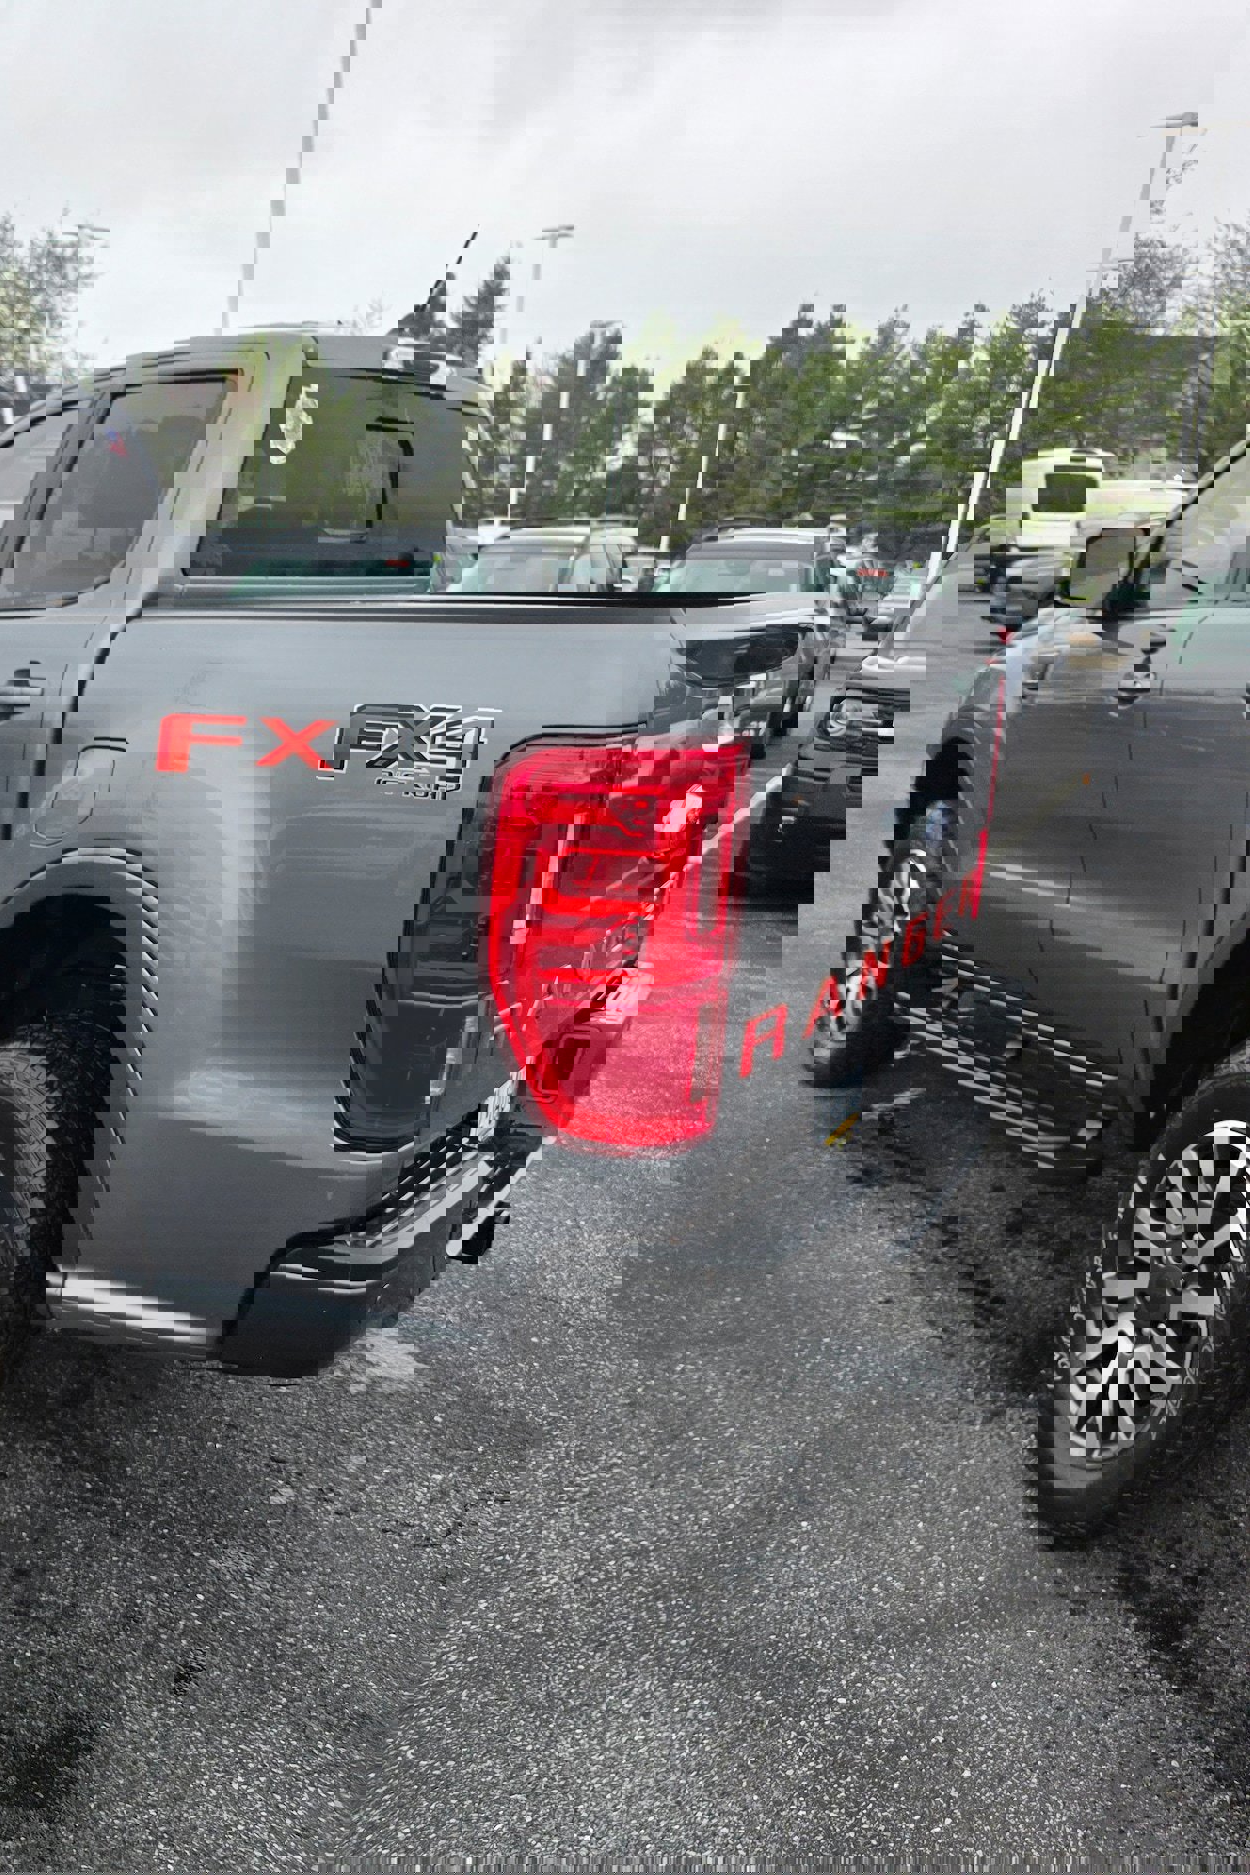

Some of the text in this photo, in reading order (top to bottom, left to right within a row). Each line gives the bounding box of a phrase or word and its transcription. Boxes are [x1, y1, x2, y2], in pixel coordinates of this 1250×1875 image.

[149, 706, 447, 783] FX4
[271, 778, 437, 802] OFF ROAD
[739, 867, 977, 1079] RANGER
